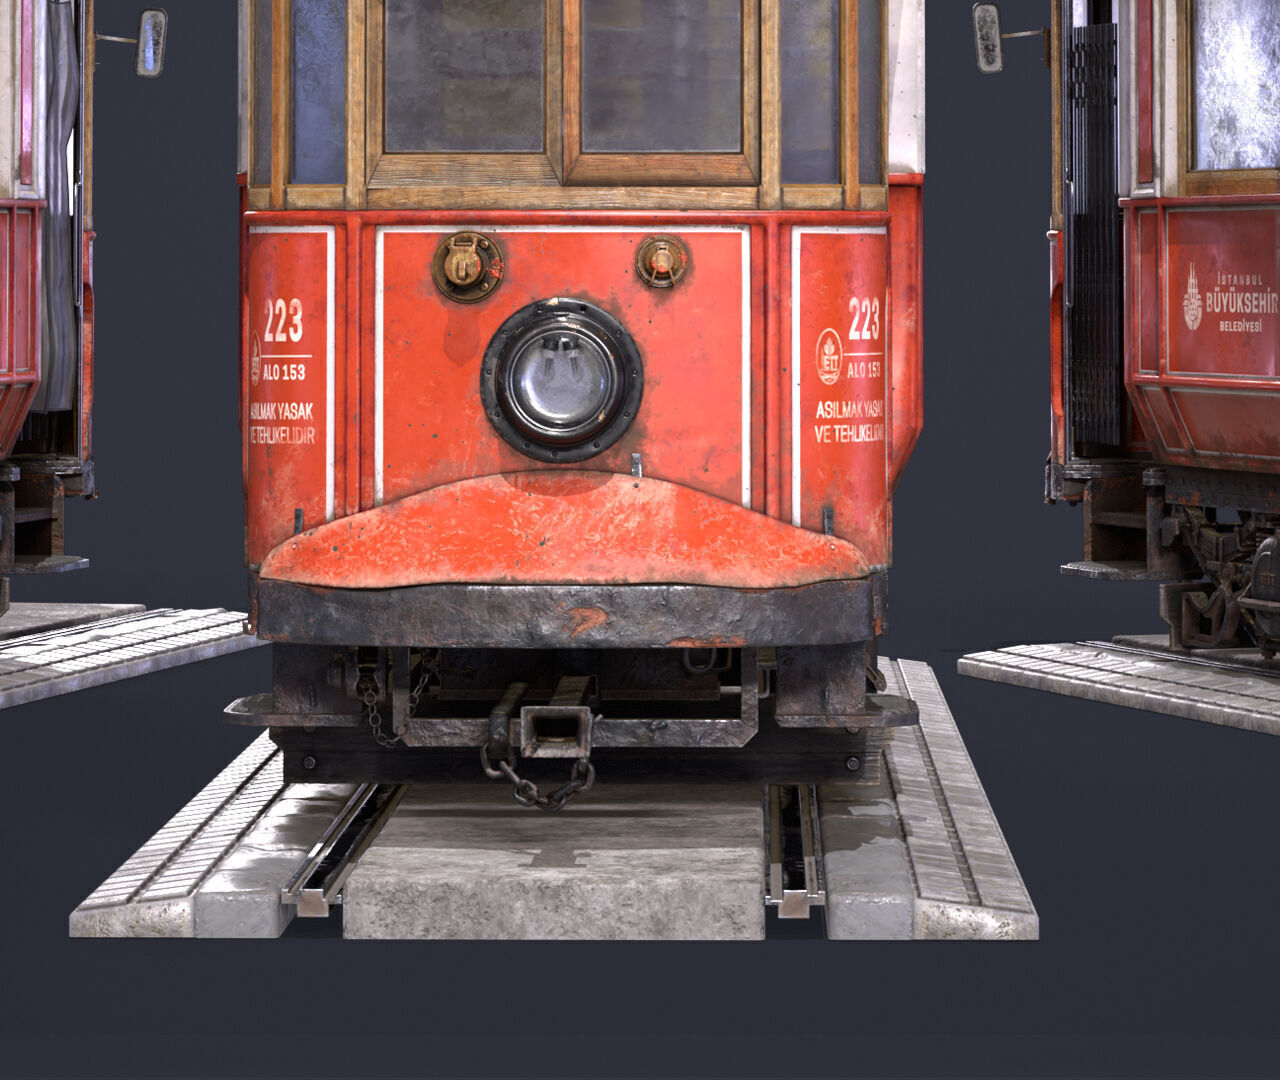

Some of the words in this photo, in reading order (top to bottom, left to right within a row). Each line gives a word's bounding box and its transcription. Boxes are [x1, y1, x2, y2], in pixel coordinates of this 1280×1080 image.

[1217, 271, 1263, 286] İSTANBUL
[264, 298, 303, 343] 223
[848, 296, 880, 340] 223
[1219, 318, 1263, 333] BELEDİYESİ
[263, 364, 280, 381] ALO
[282, 364, 306, 381] 153
[847, 362, 866, 379] ALO
[867, 361, 881, 378] 153
[277, 402, 313, 420] YASAK
[816, 400, 863, 419] ASILMAK
[863, 399, 884, 418] YASAK
[815, 425, 832, 443] VE
